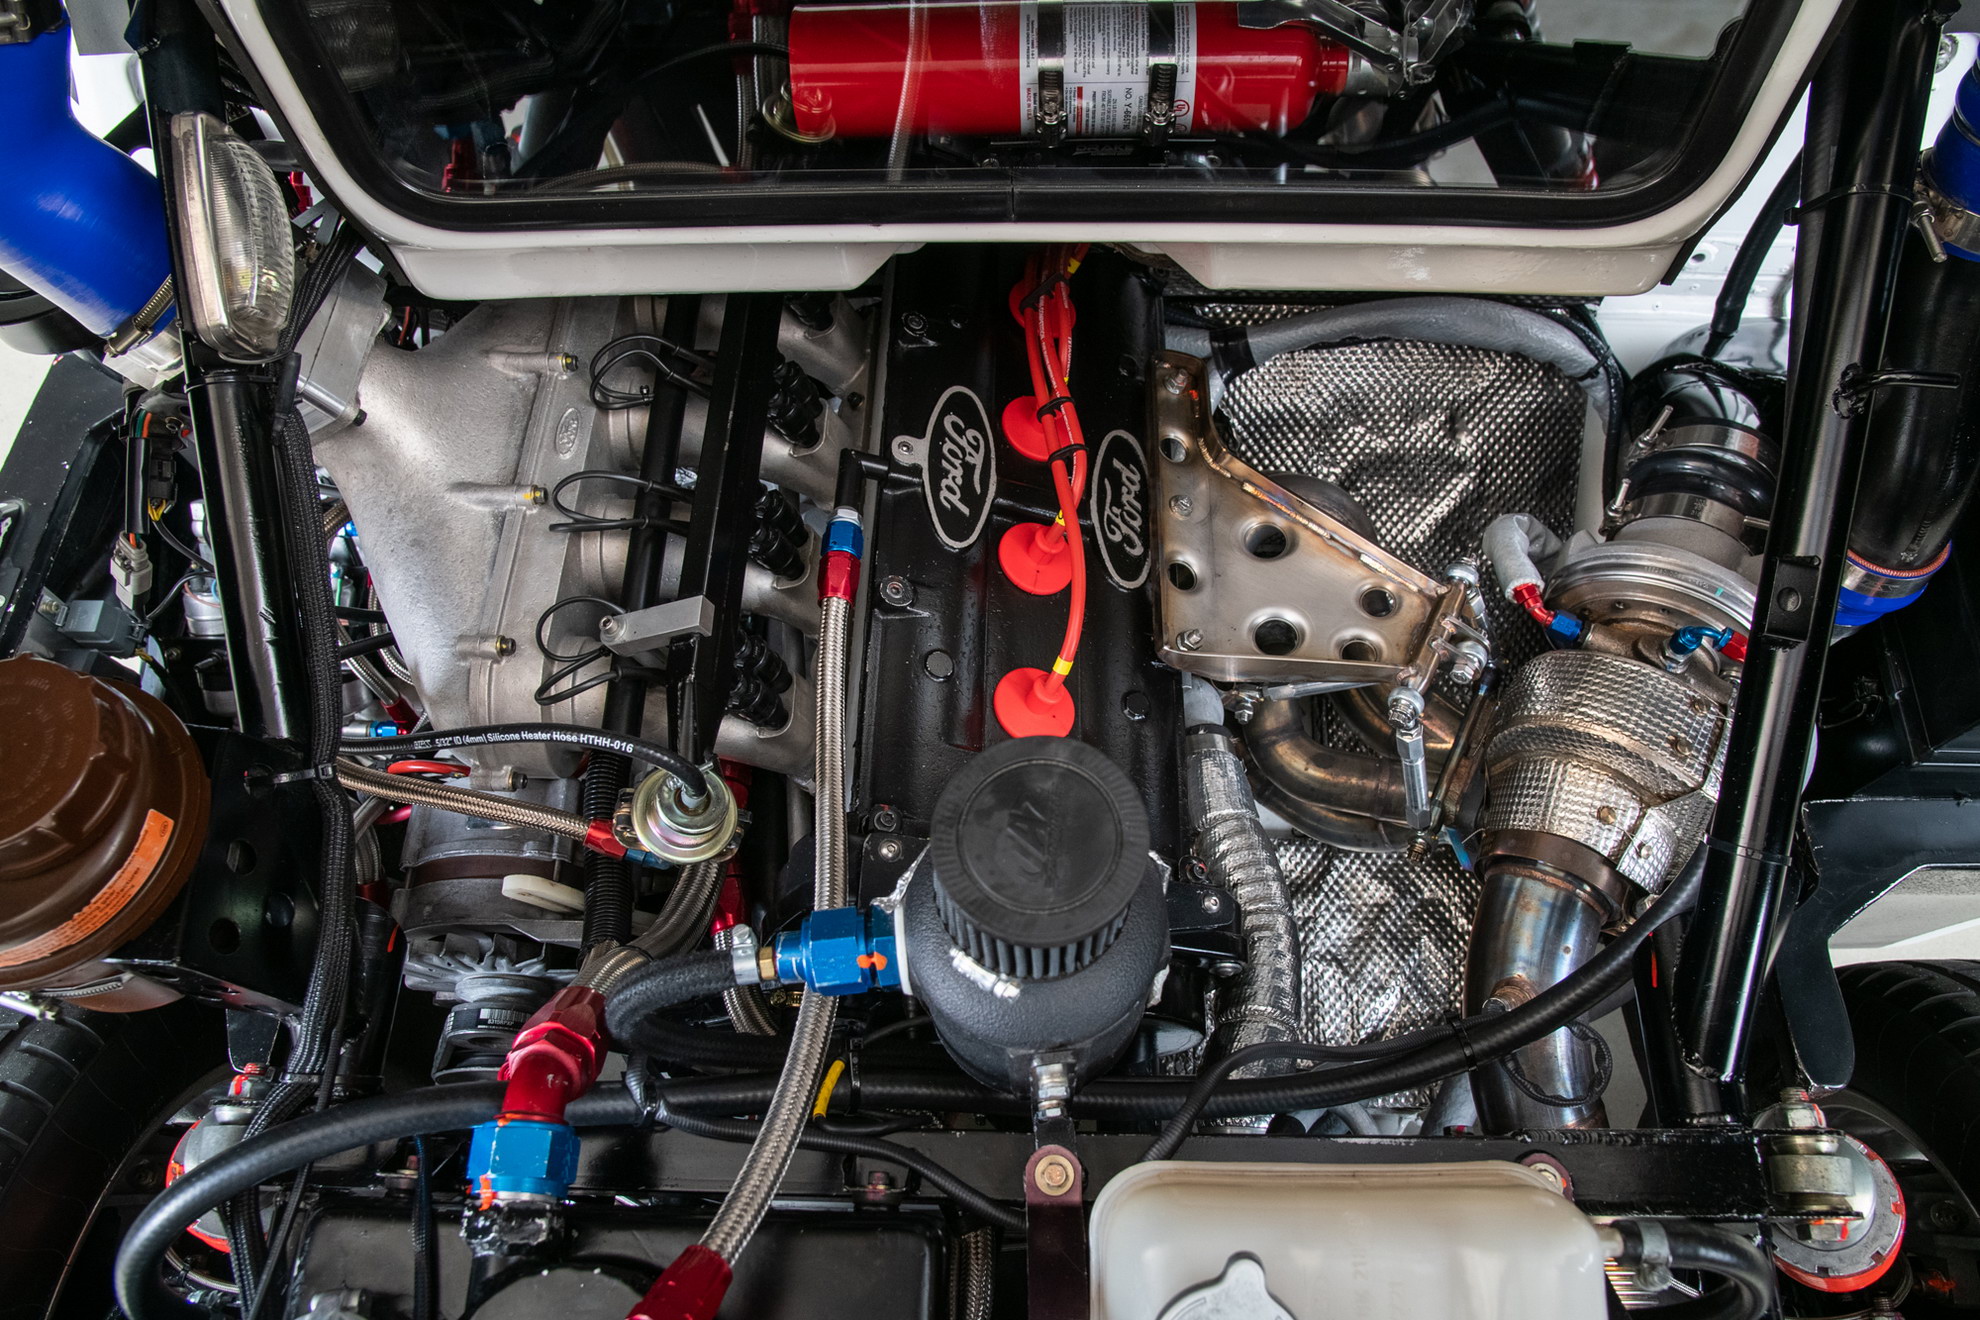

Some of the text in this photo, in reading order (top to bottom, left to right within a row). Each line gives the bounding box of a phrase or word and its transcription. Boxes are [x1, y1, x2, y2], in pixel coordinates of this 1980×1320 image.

[939, 413, 985, 517] Ford
[1104, 457, 1145, 557] Ford
[453, 735, 463, 745] ID
[486, 732, 521, 742] Silicone
[521, 730, 551, 741] Heater
[552, 731, 578, 742] Hose
[579, 733, 634, 753] HTHH-016
